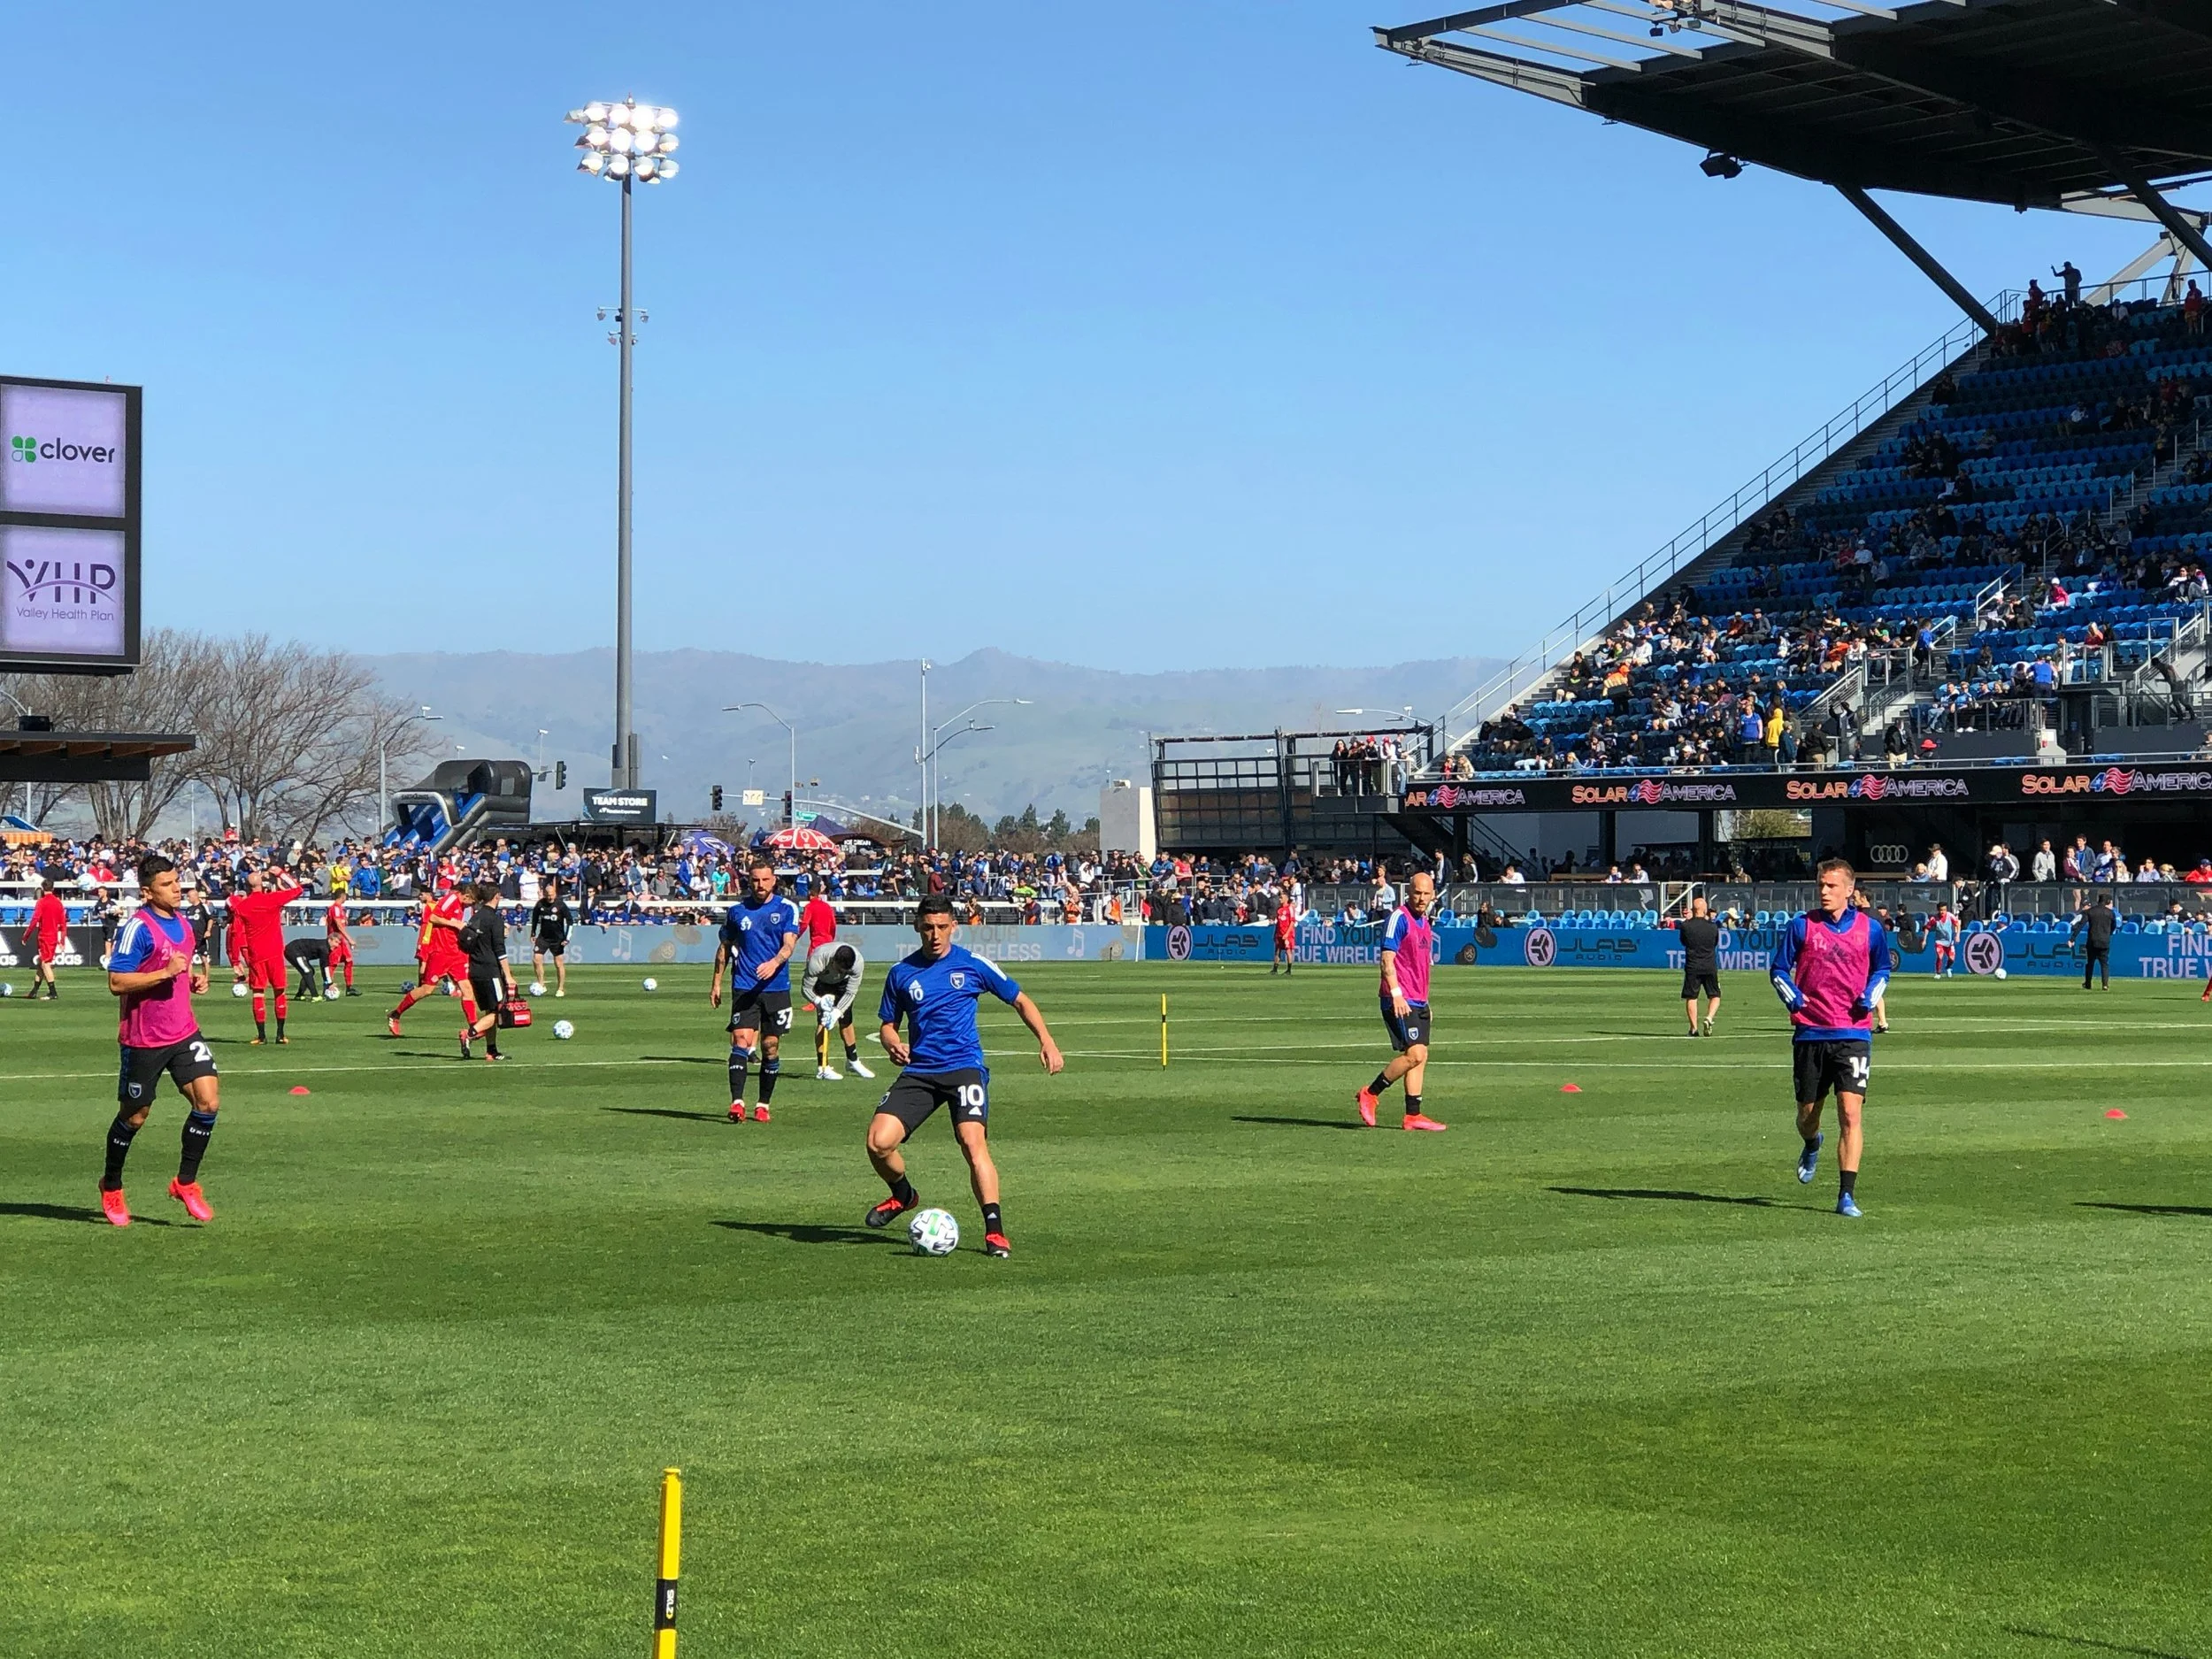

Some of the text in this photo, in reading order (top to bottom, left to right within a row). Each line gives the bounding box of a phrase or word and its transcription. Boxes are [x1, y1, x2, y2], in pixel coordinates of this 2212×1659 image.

[40, 437, 115, 463] clover
[6, 559, 116, 604] VHP
[16, 606, 114, 621] Valley Health Plan
[592, 796, 648, 807] TEAM STORE
[740, 921, 752, 932] 37
[1302, 926, 1336, 945] FIND
[1292, 945, 1323, 963] RUE
[1813, 940, 1827, 950] 14
[2139, 956, 2199, 979] TRUE
[909, 988, 924, 1002] 10
[777, 1007, 793, 1030] 37
[1849, 1056, 1870, 1079] 14
[957, 1084, 985, 1107] 10
[665, 1589, 675, 1617] SKLZ
